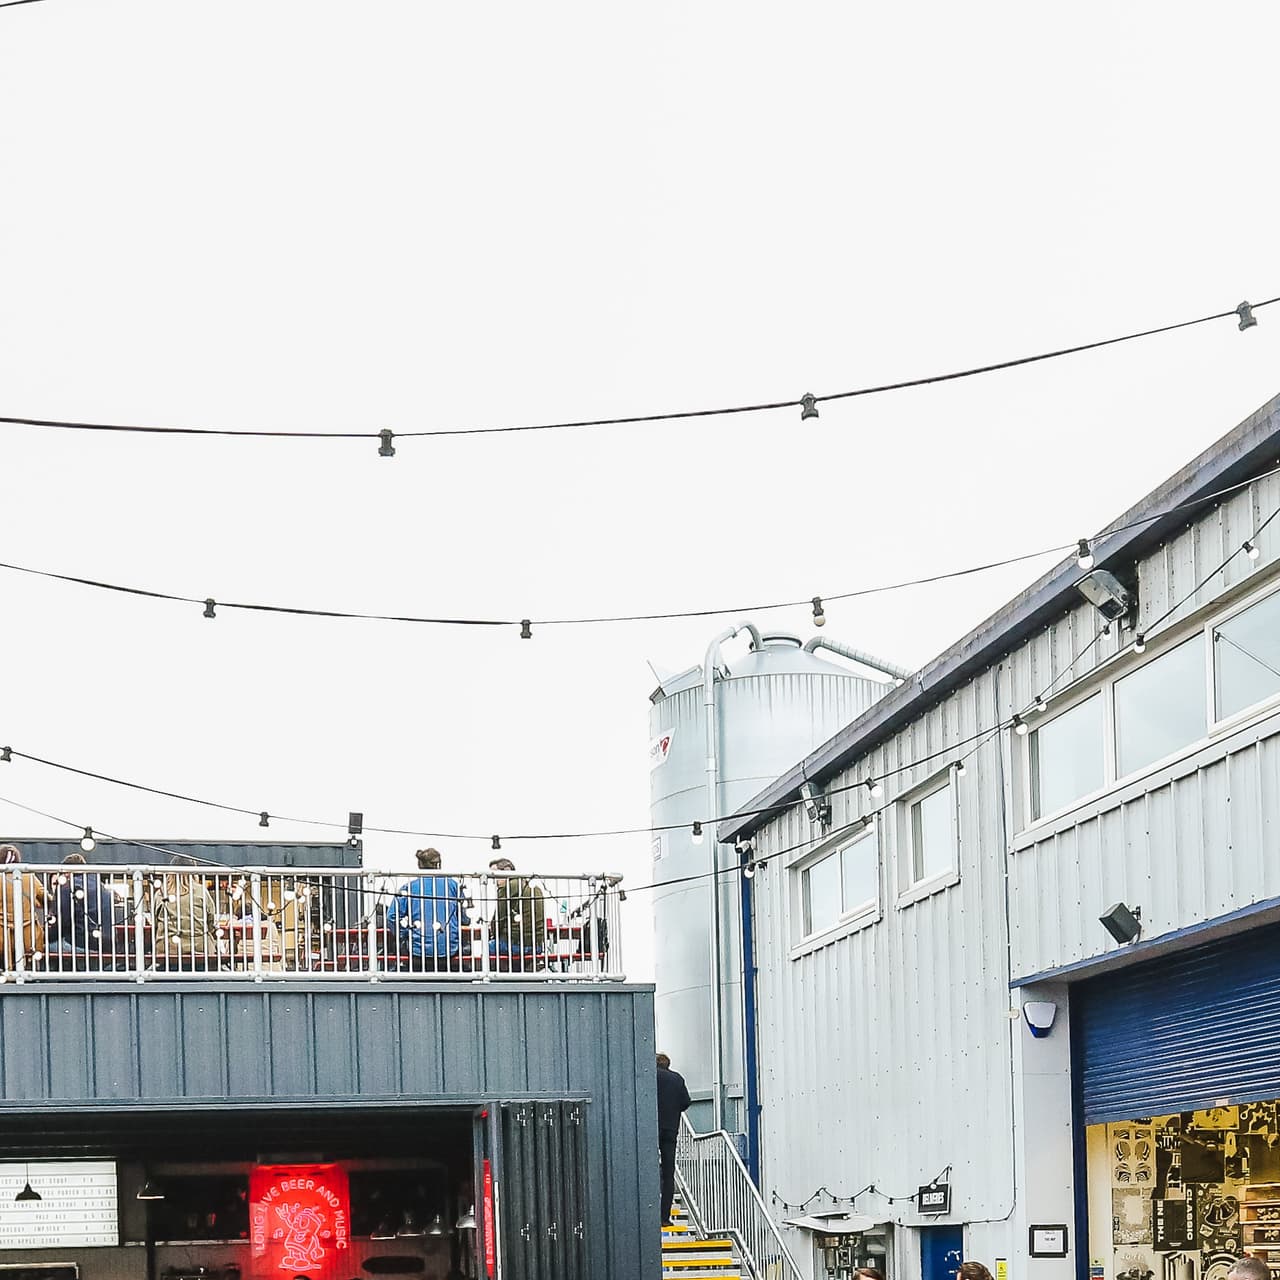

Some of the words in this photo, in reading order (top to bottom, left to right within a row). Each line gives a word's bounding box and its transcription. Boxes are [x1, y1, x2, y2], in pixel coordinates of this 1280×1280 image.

[257, 1186, 280, 1214] LIVE
[280, 1179, 315, 1192] BEER
[316, 1186, 340, 1208] AND
[334, 1209, 347, 1250] MUSIC
[1186, 1189, 1194, 1241] CLASSIC
[254, 1215, 265, 1251] LONG
